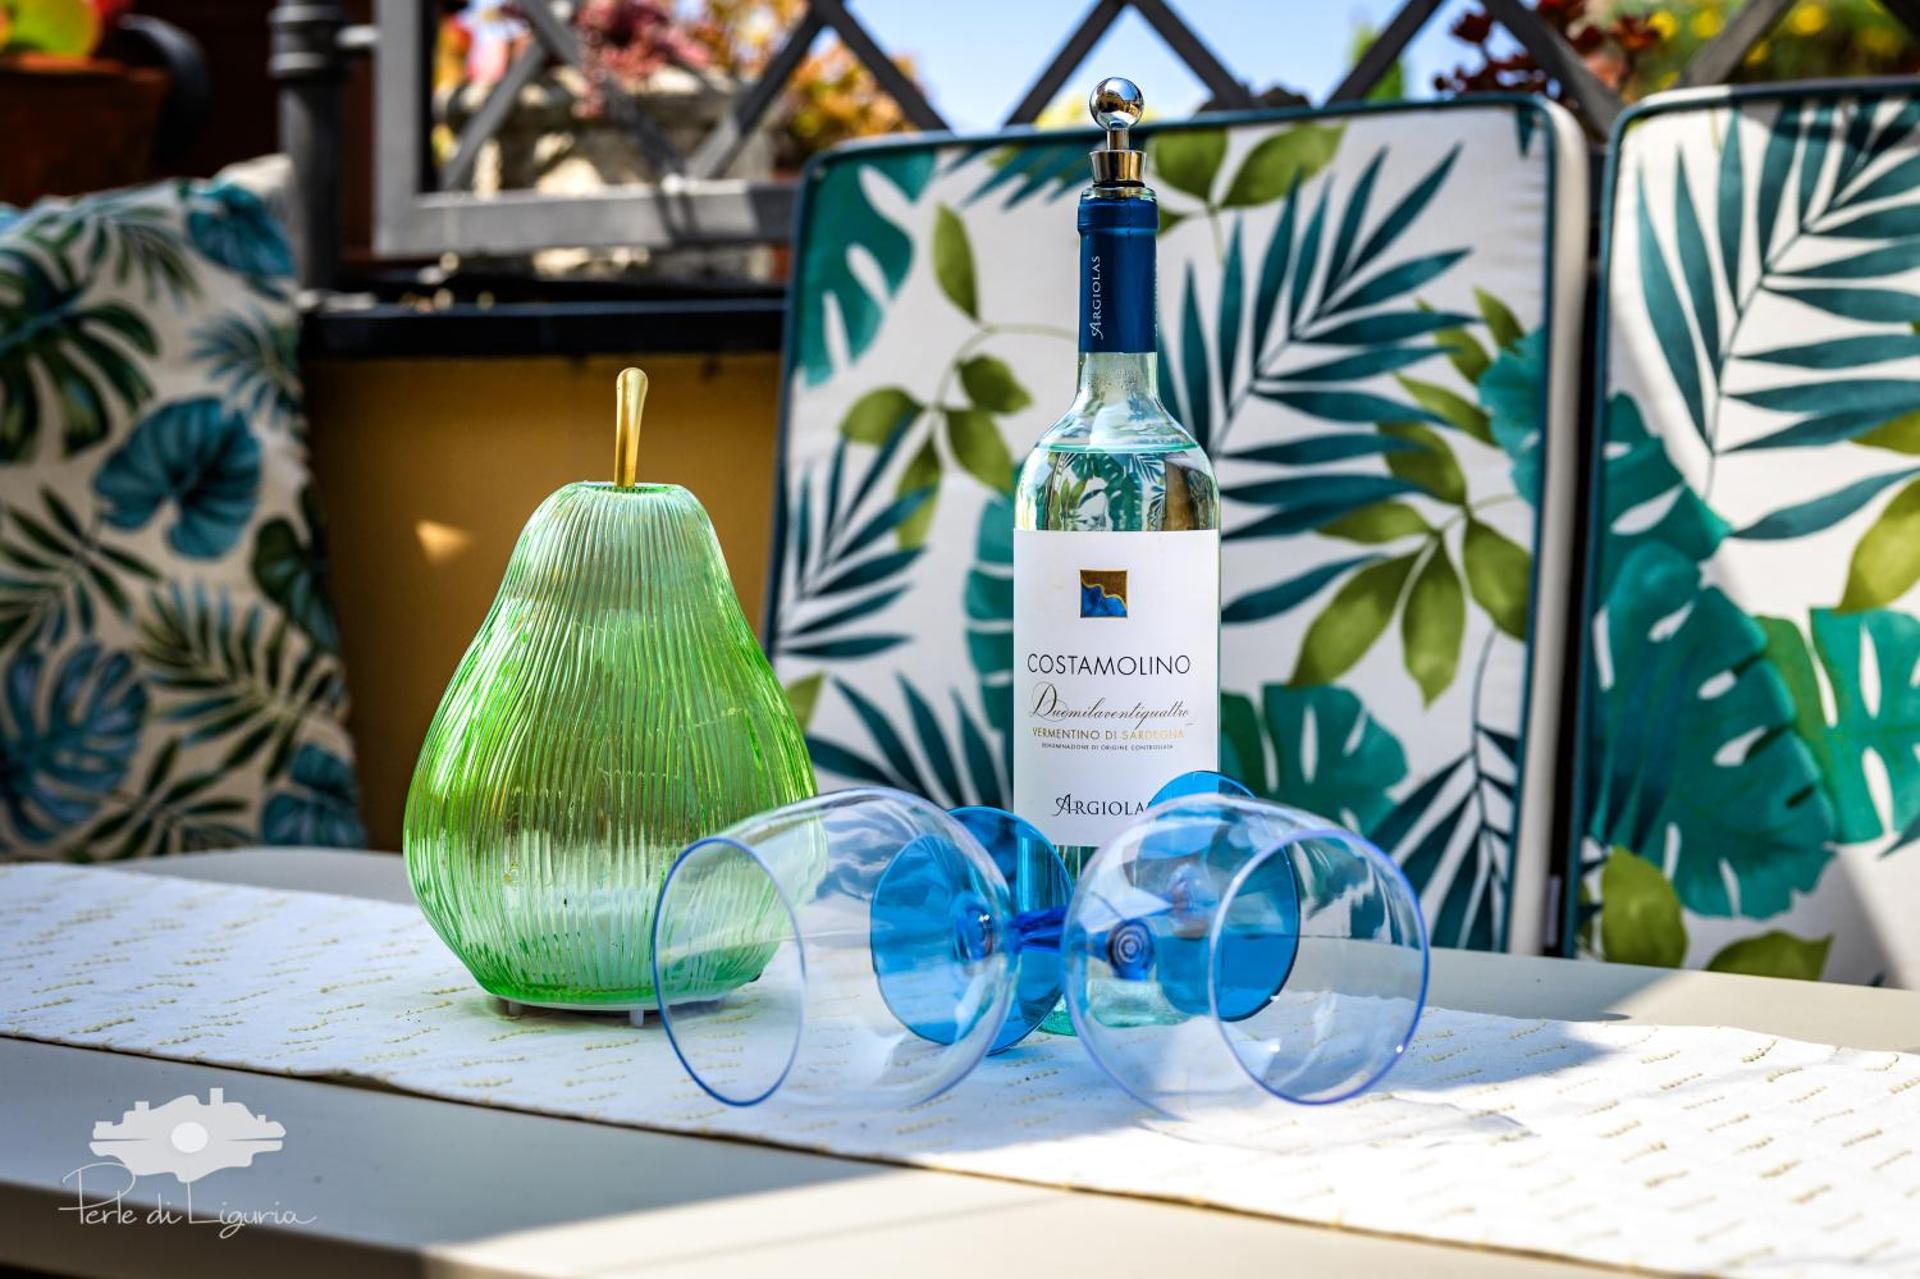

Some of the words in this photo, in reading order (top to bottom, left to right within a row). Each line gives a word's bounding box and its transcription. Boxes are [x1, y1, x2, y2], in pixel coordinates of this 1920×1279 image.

[1088, 255, 1104, 340] ARGIOLAS
[1027, 653, 1191, 676] COSTAMOLINO
[1030, 681, 1190, 730] Duomilaventiquattro
[1032, 727, 1100, 740] VERMENTINO
[1105, 730, 1117, 741] DI
[1121, 729, 1185, 741] SARDEGNA
[1052, 793, 1146, 816] ARGIOLA
